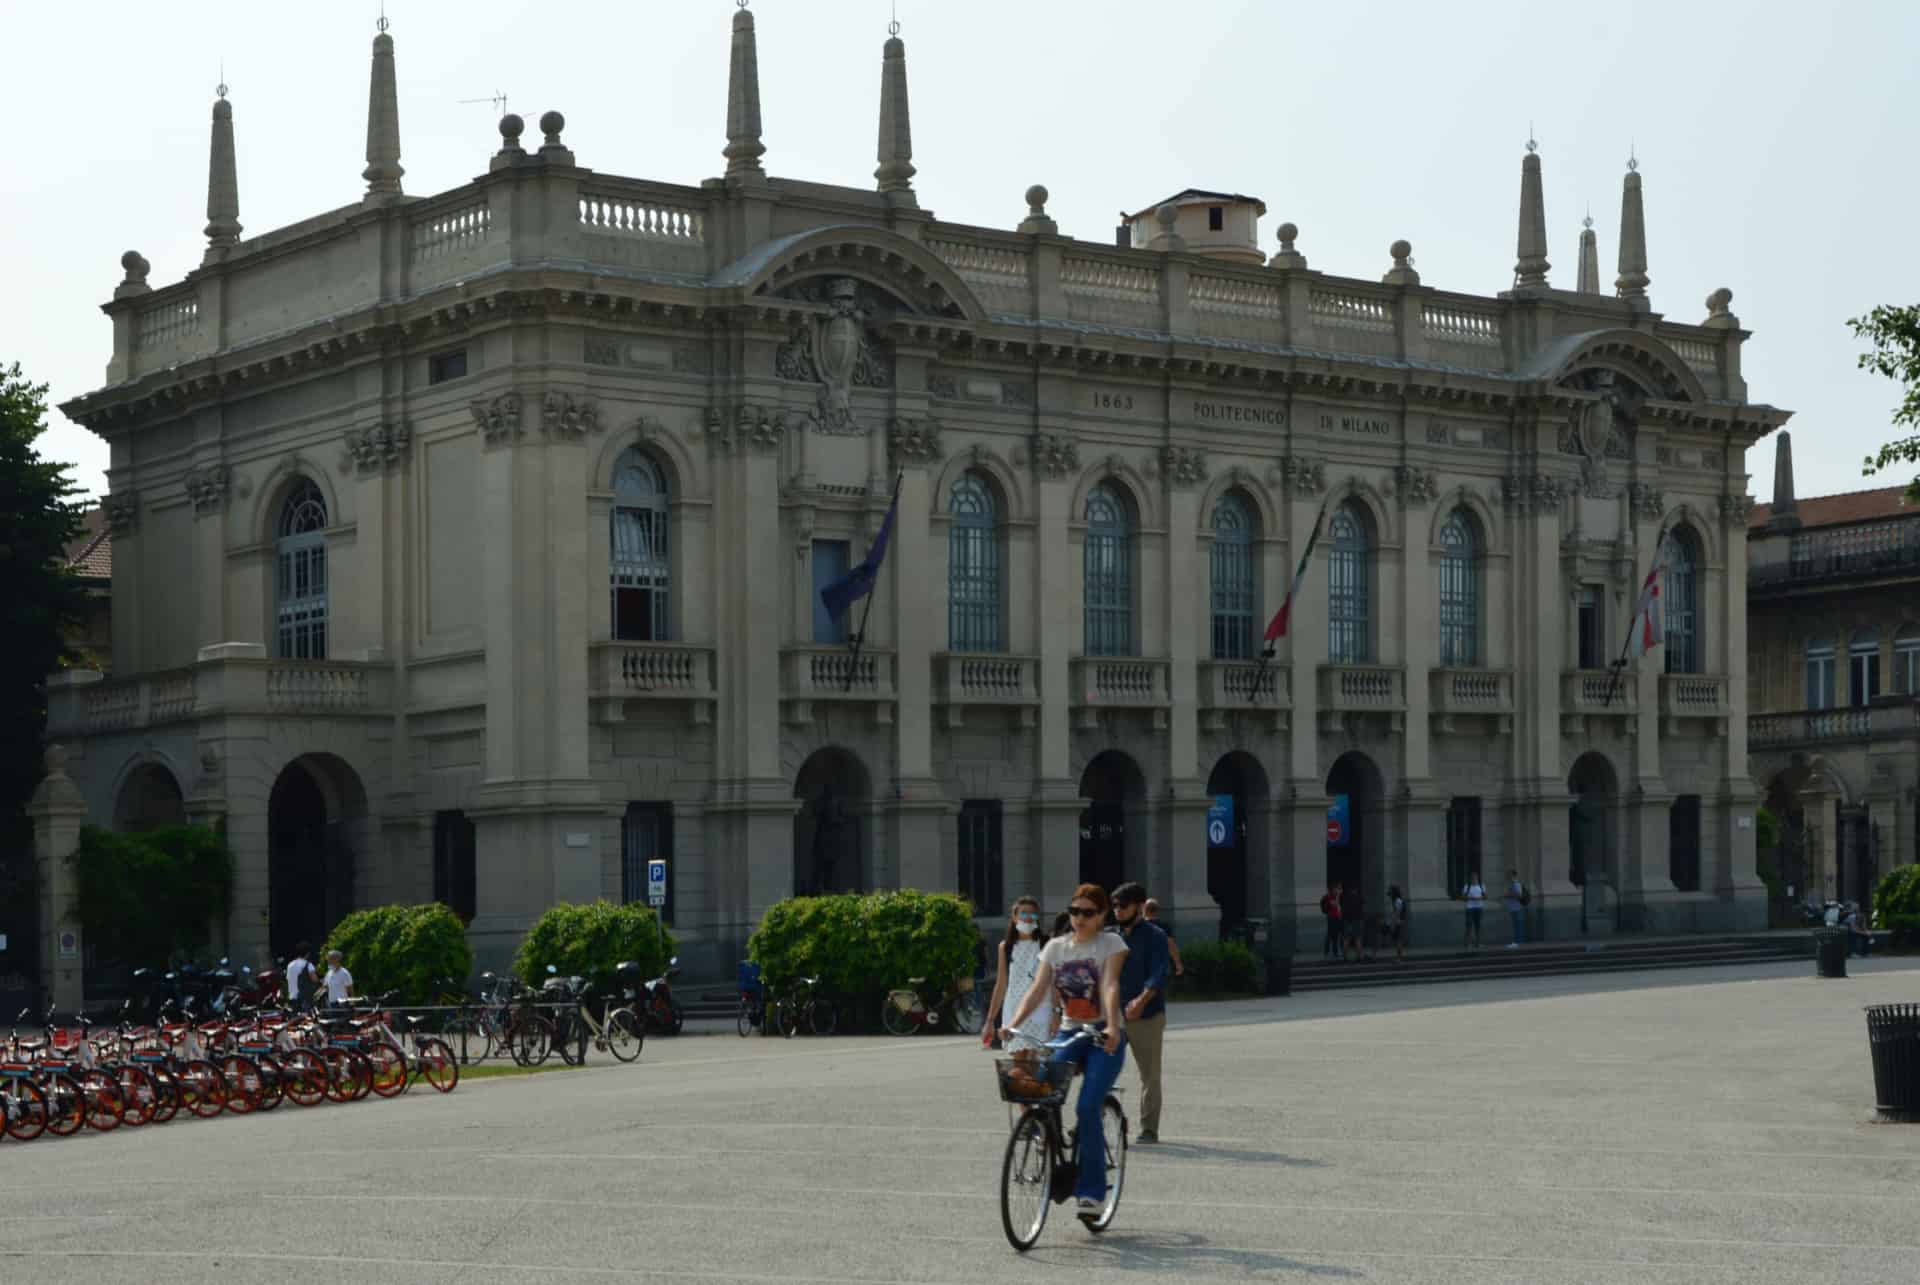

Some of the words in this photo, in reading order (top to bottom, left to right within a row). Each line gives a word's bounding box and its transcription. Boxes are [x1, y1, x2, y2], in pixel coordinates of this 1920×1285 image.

[1093, 391, 1133, 410] 1863
[1193, 402, 1285, 425] POLITECNICO
[1341, 416, 1390, 434] MILANO
[653, 866, 662, 881] P
